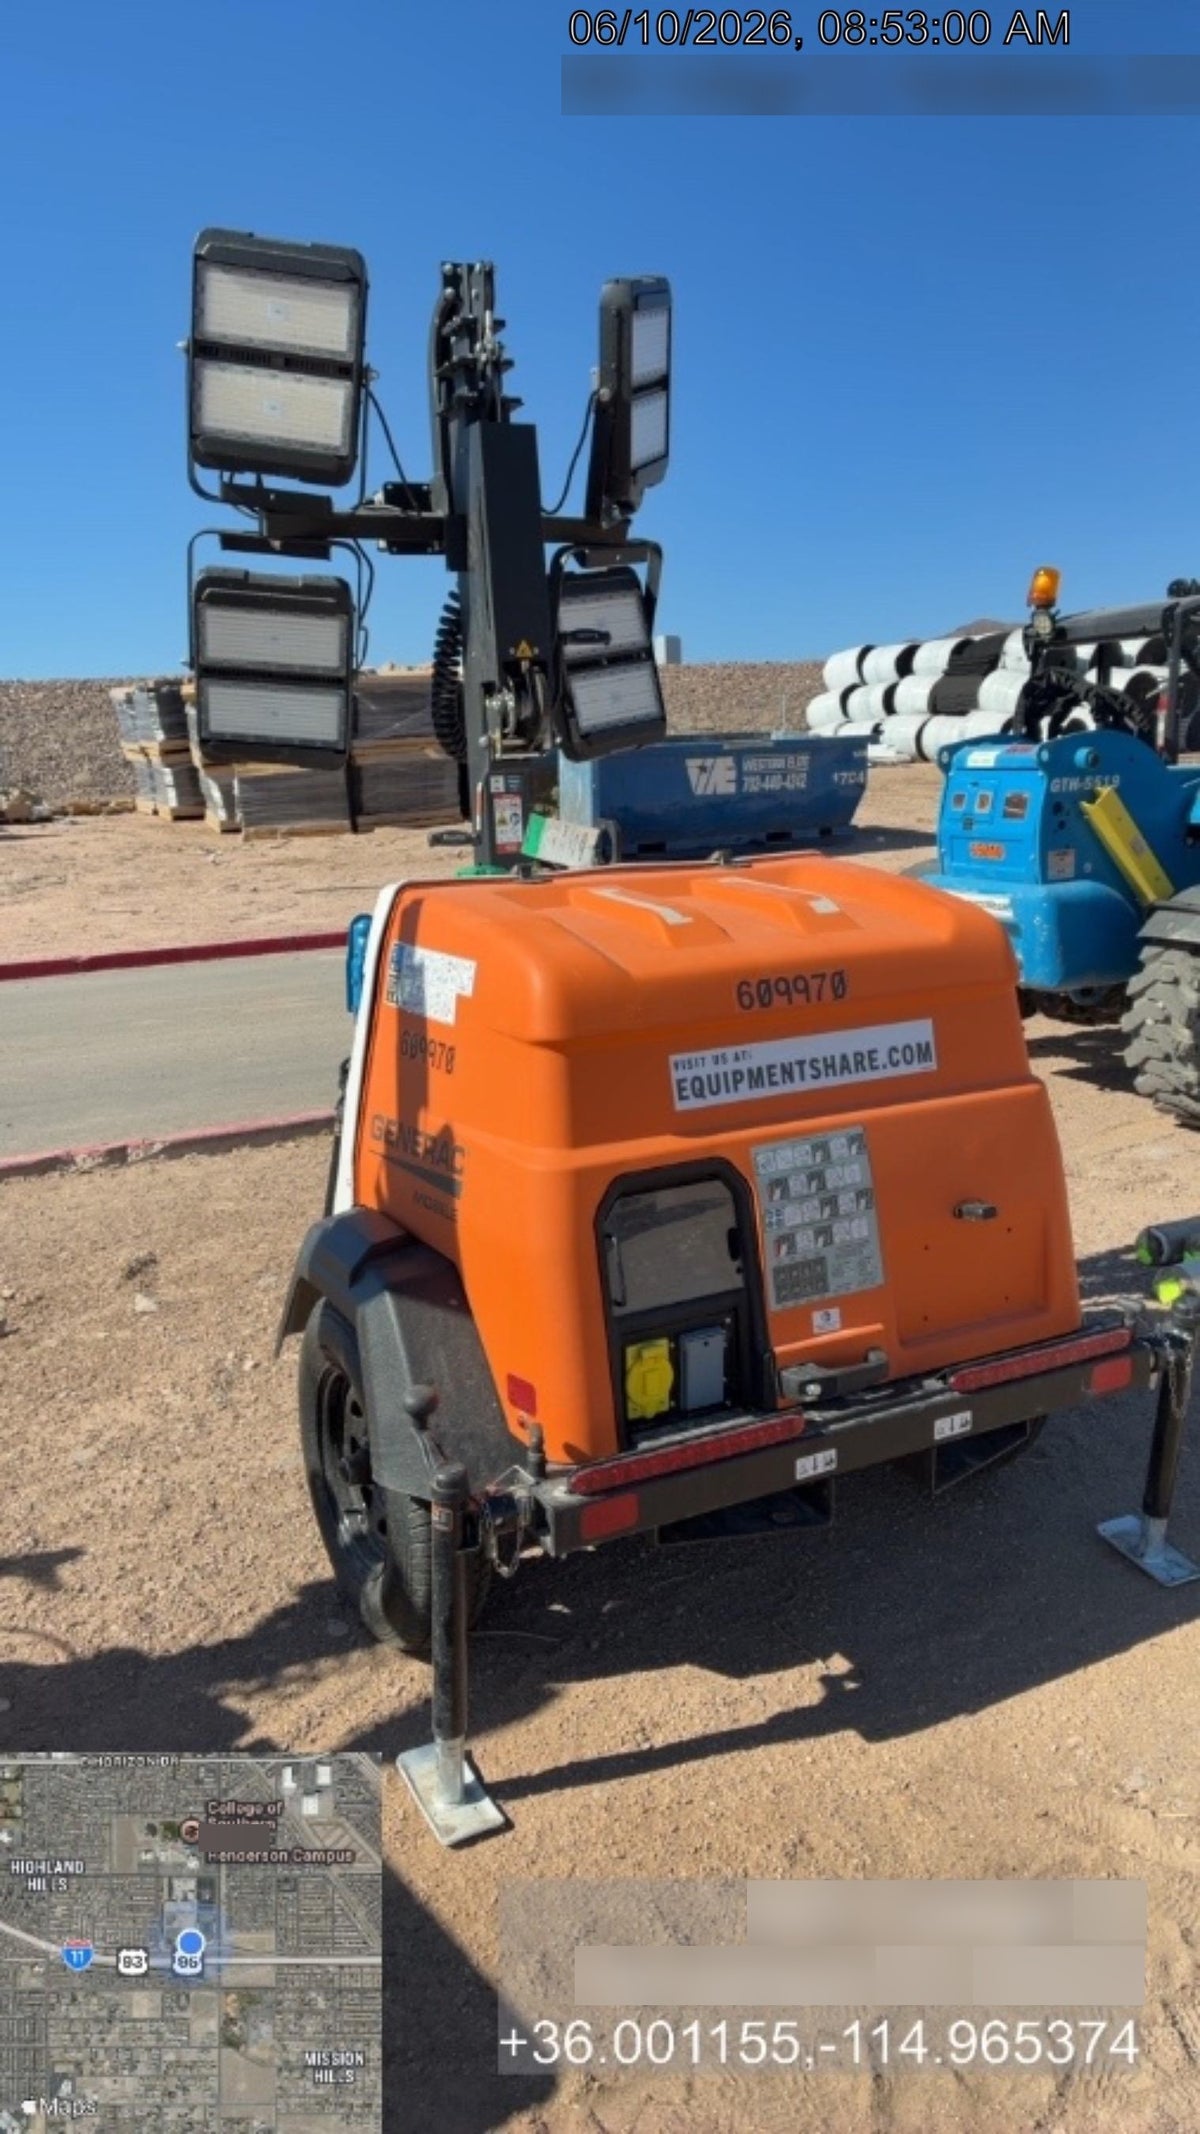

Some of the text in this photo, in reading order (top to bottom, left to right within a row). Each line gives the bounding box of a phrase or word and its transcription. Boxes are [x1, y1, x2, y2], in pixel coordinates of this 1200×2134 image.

[736, 969, 848, 1011] 609970
[401, 1029, 456, 1075] 609970
[673, 1056, 706, 1072] VISIT
[712, 1052, 729, 1067] US
[675, 1040, 934, 1102] EQUIPMENTSHARE.COM
[371, 1114, 466, 1176] GENERAC
